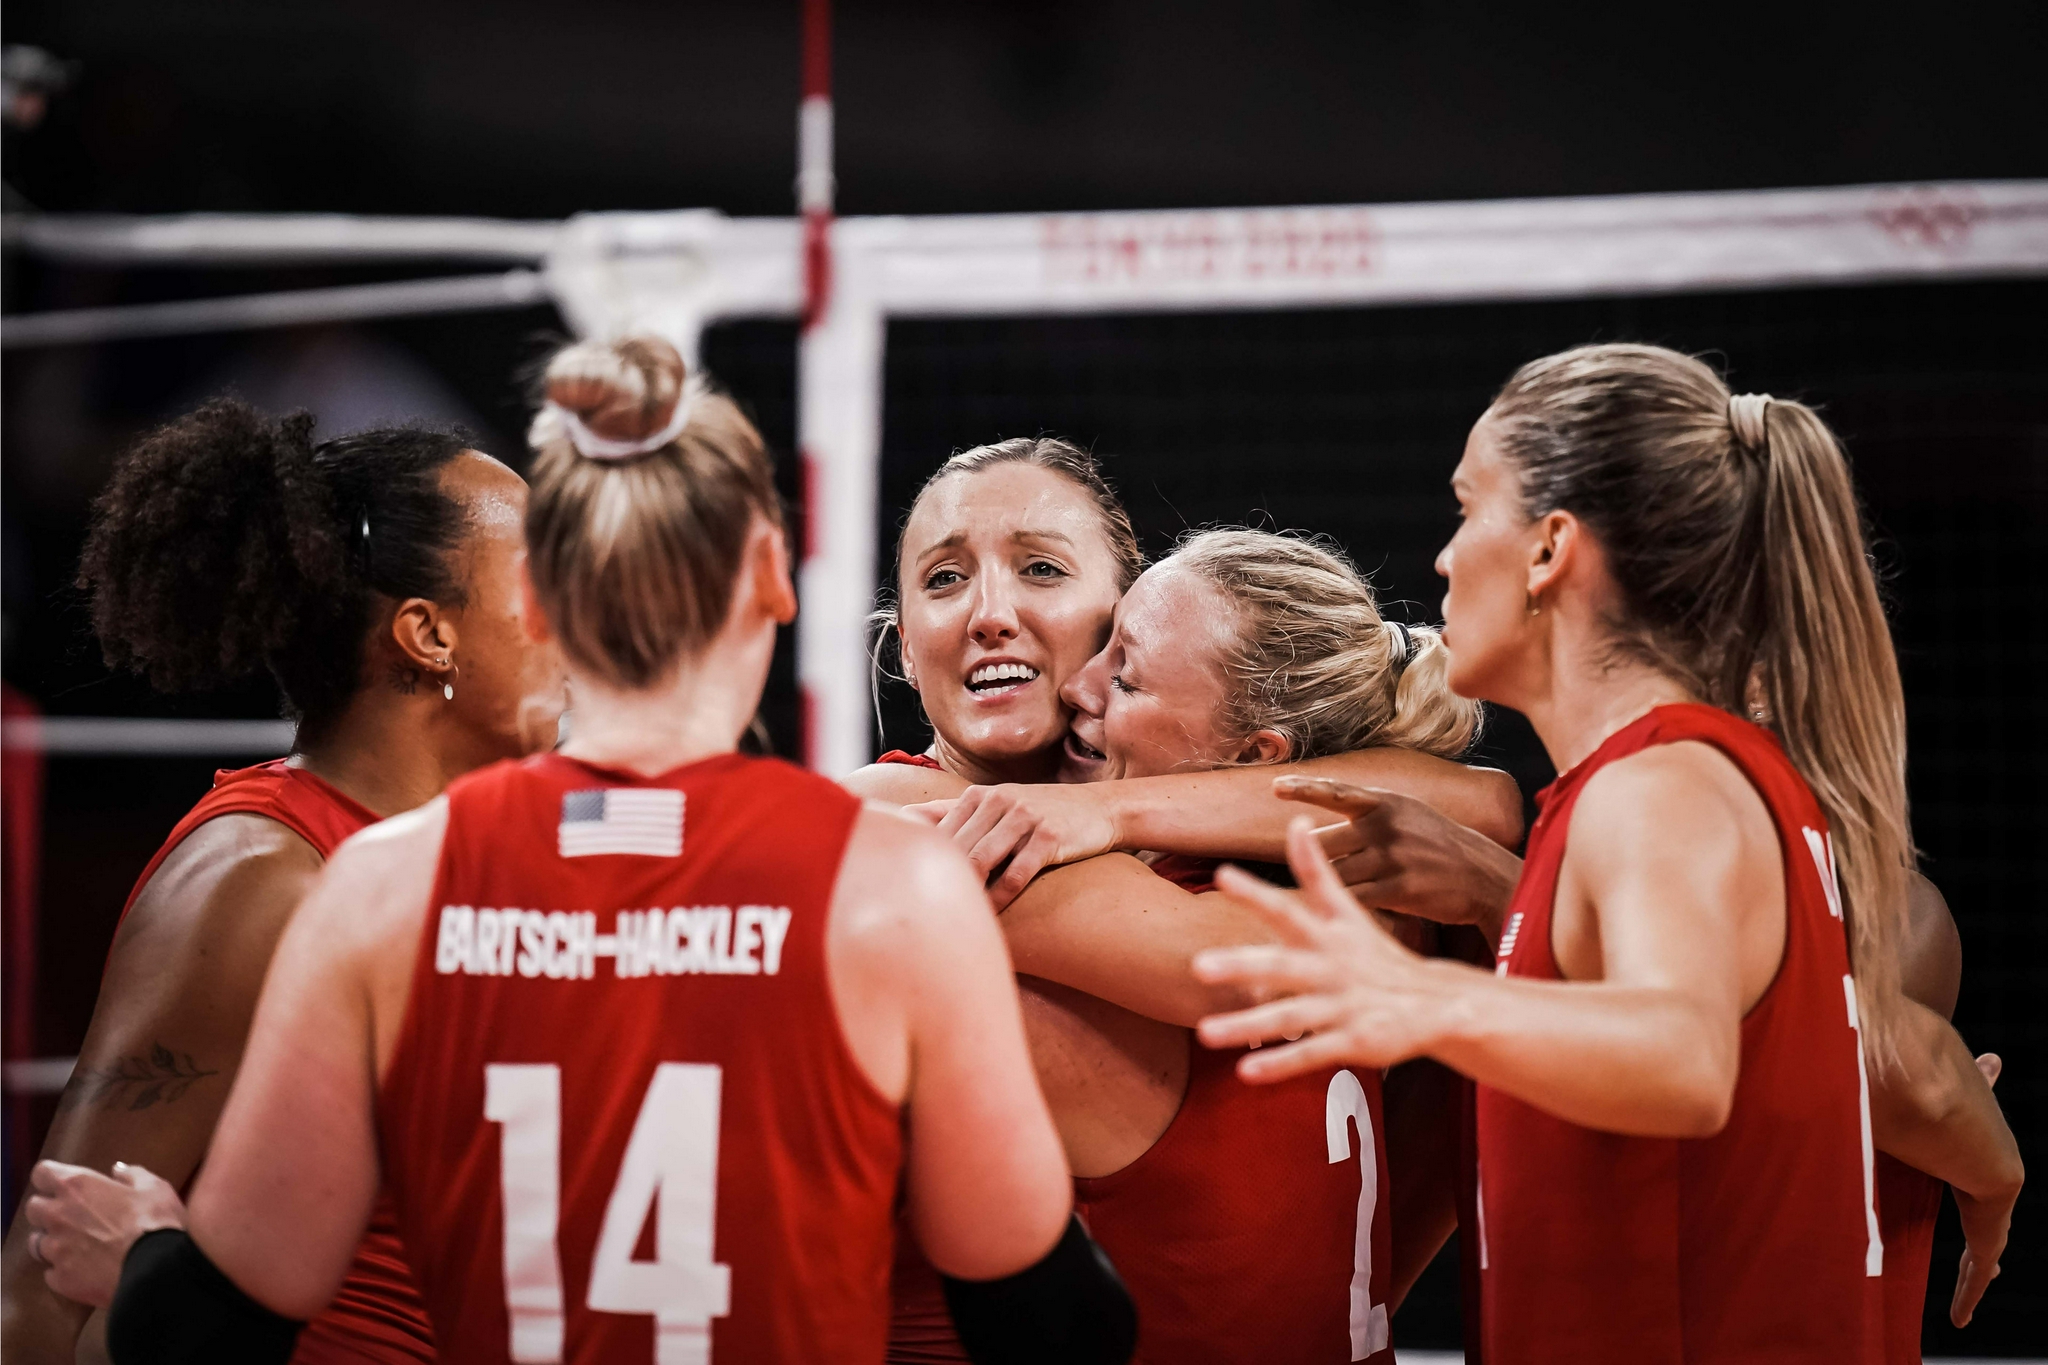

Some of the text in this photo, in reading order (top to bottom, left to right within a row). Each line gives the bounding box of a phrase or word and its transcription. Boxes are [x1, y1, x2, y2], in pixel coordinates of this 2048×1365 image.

[436, 904, 792, 980] BARTSCH-HACKLEY
[484, 1062, 732, 1365] 14
[1325, 1069, 1389, 1362] 2
